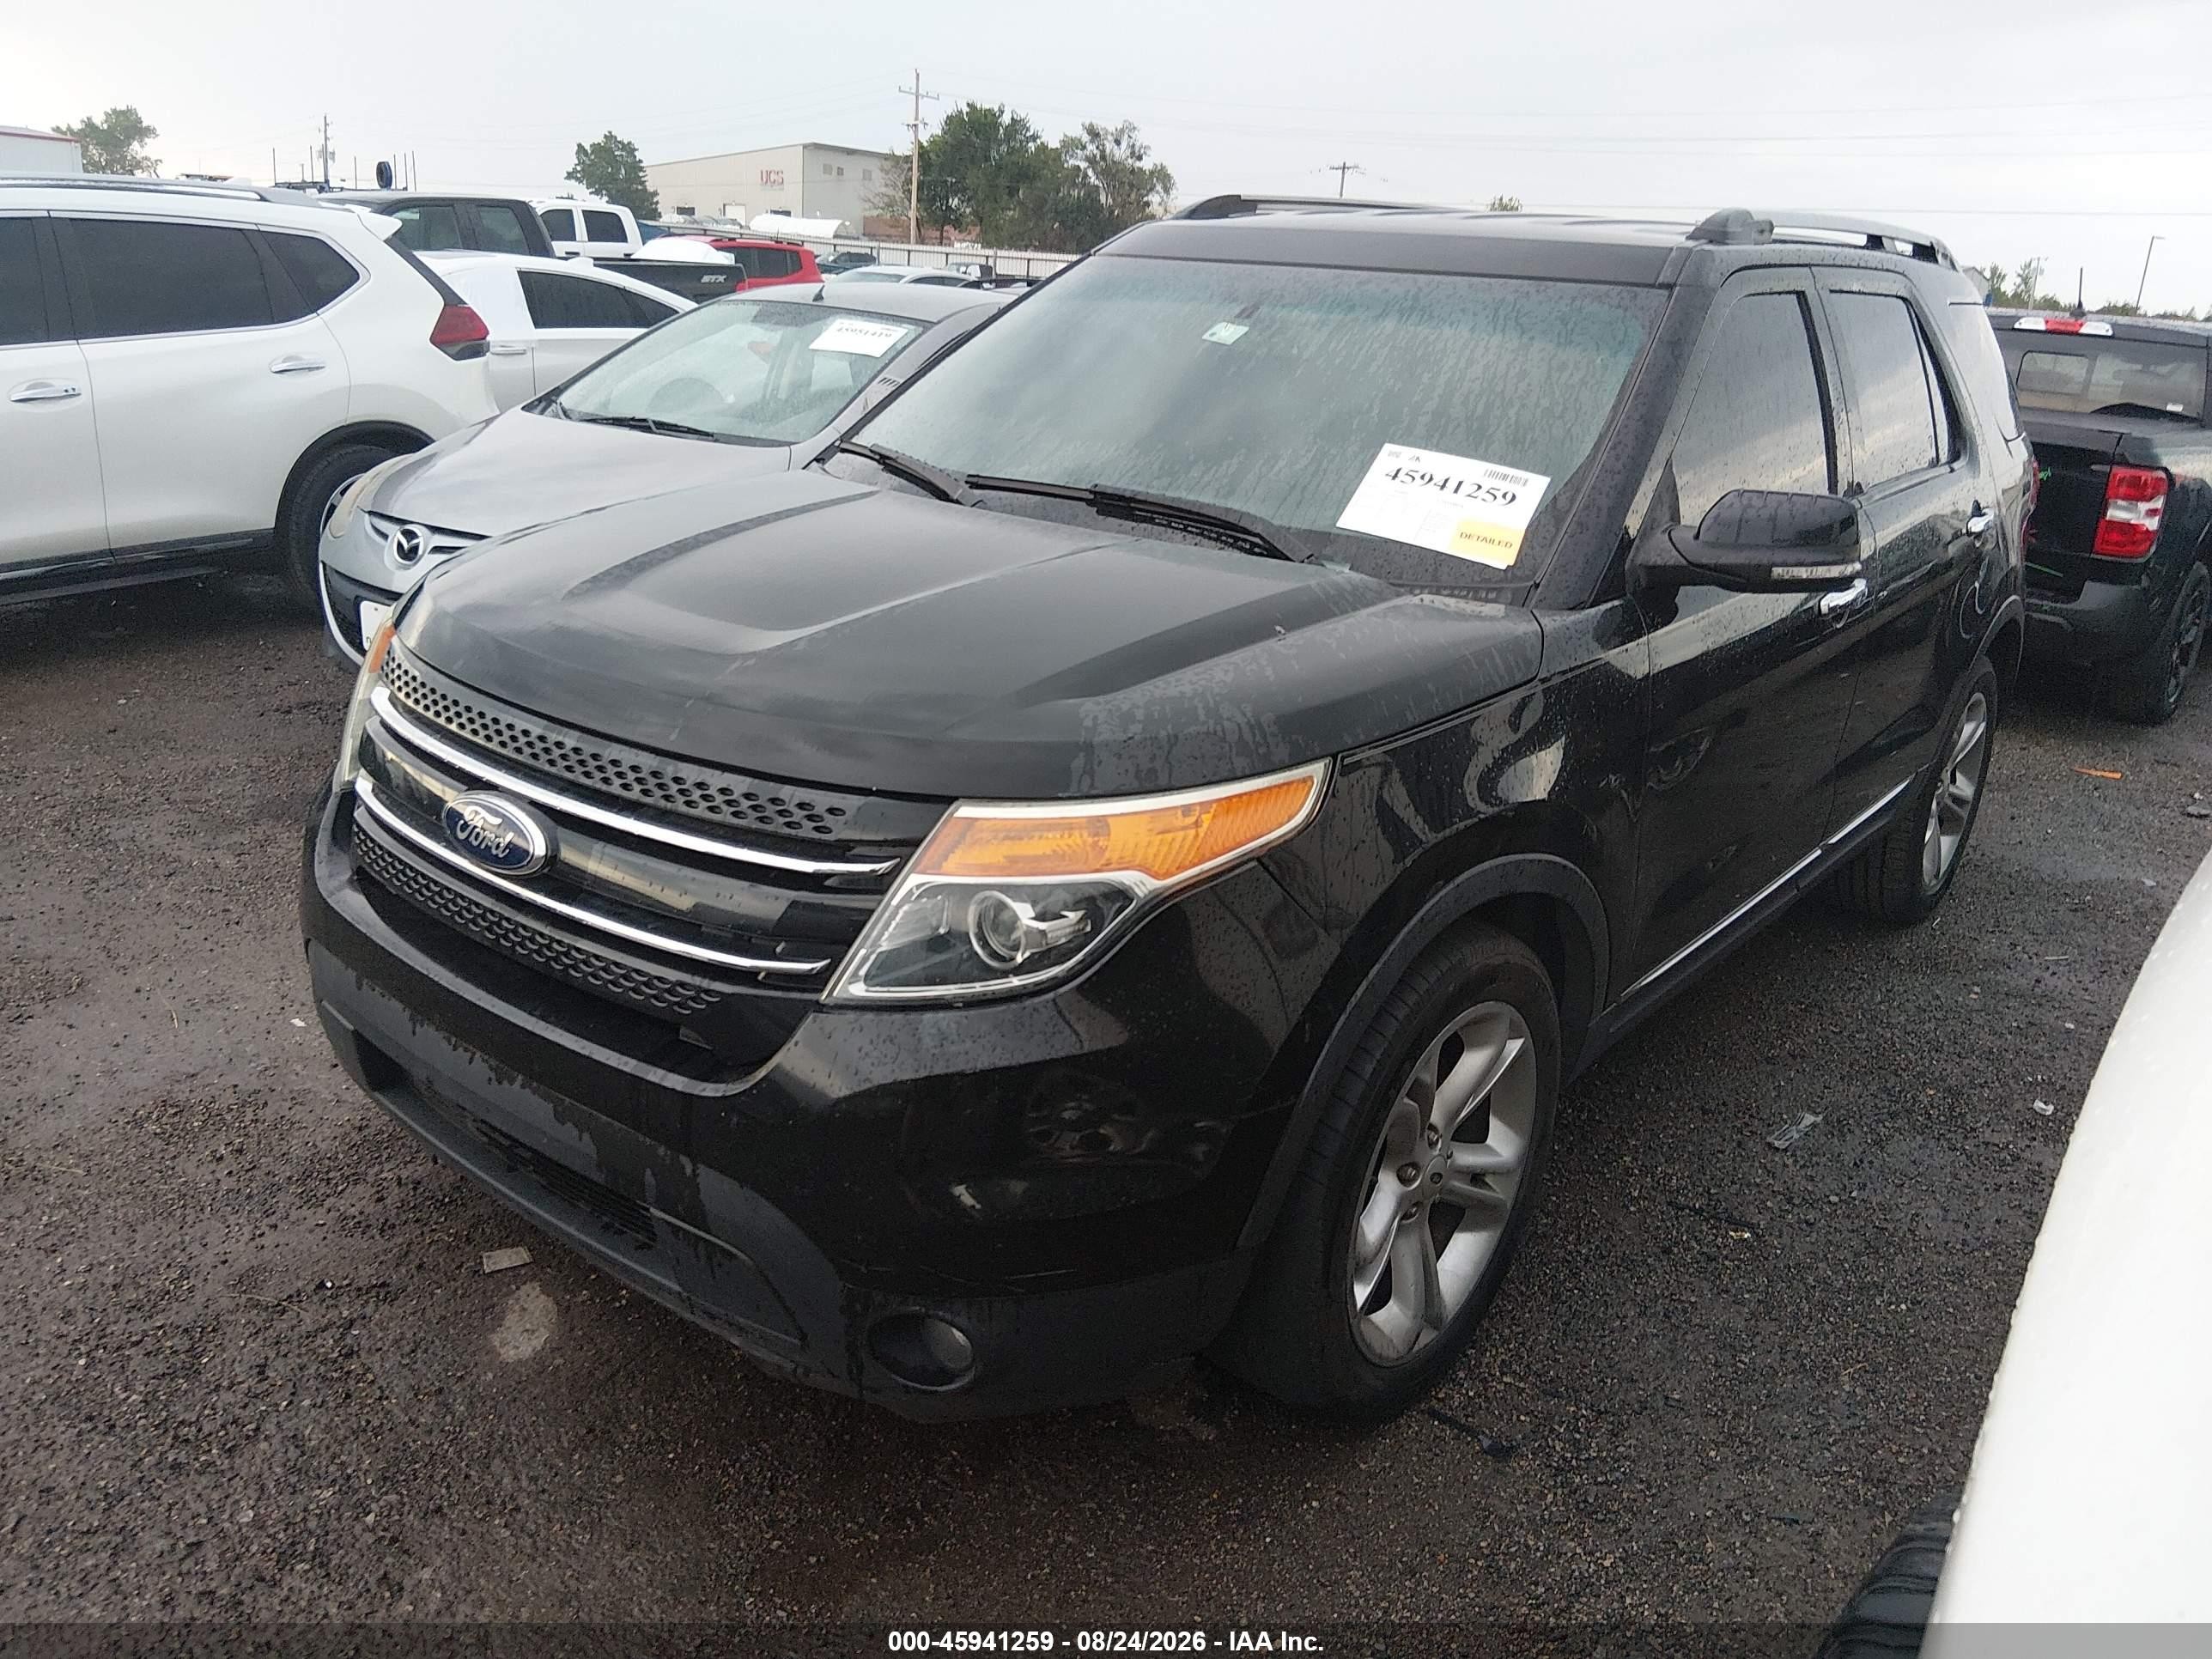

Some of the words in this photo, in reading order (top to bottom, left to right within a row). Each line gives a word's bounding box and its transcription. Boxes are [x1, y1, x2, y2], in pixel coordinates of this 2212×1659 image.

[760, 169, 783, 185] UCS
[1384, 467, 1517, 507] 45941259
[1459, 531, 1514, 550] DETAILED
[456, 805, 515, 858] Ford
